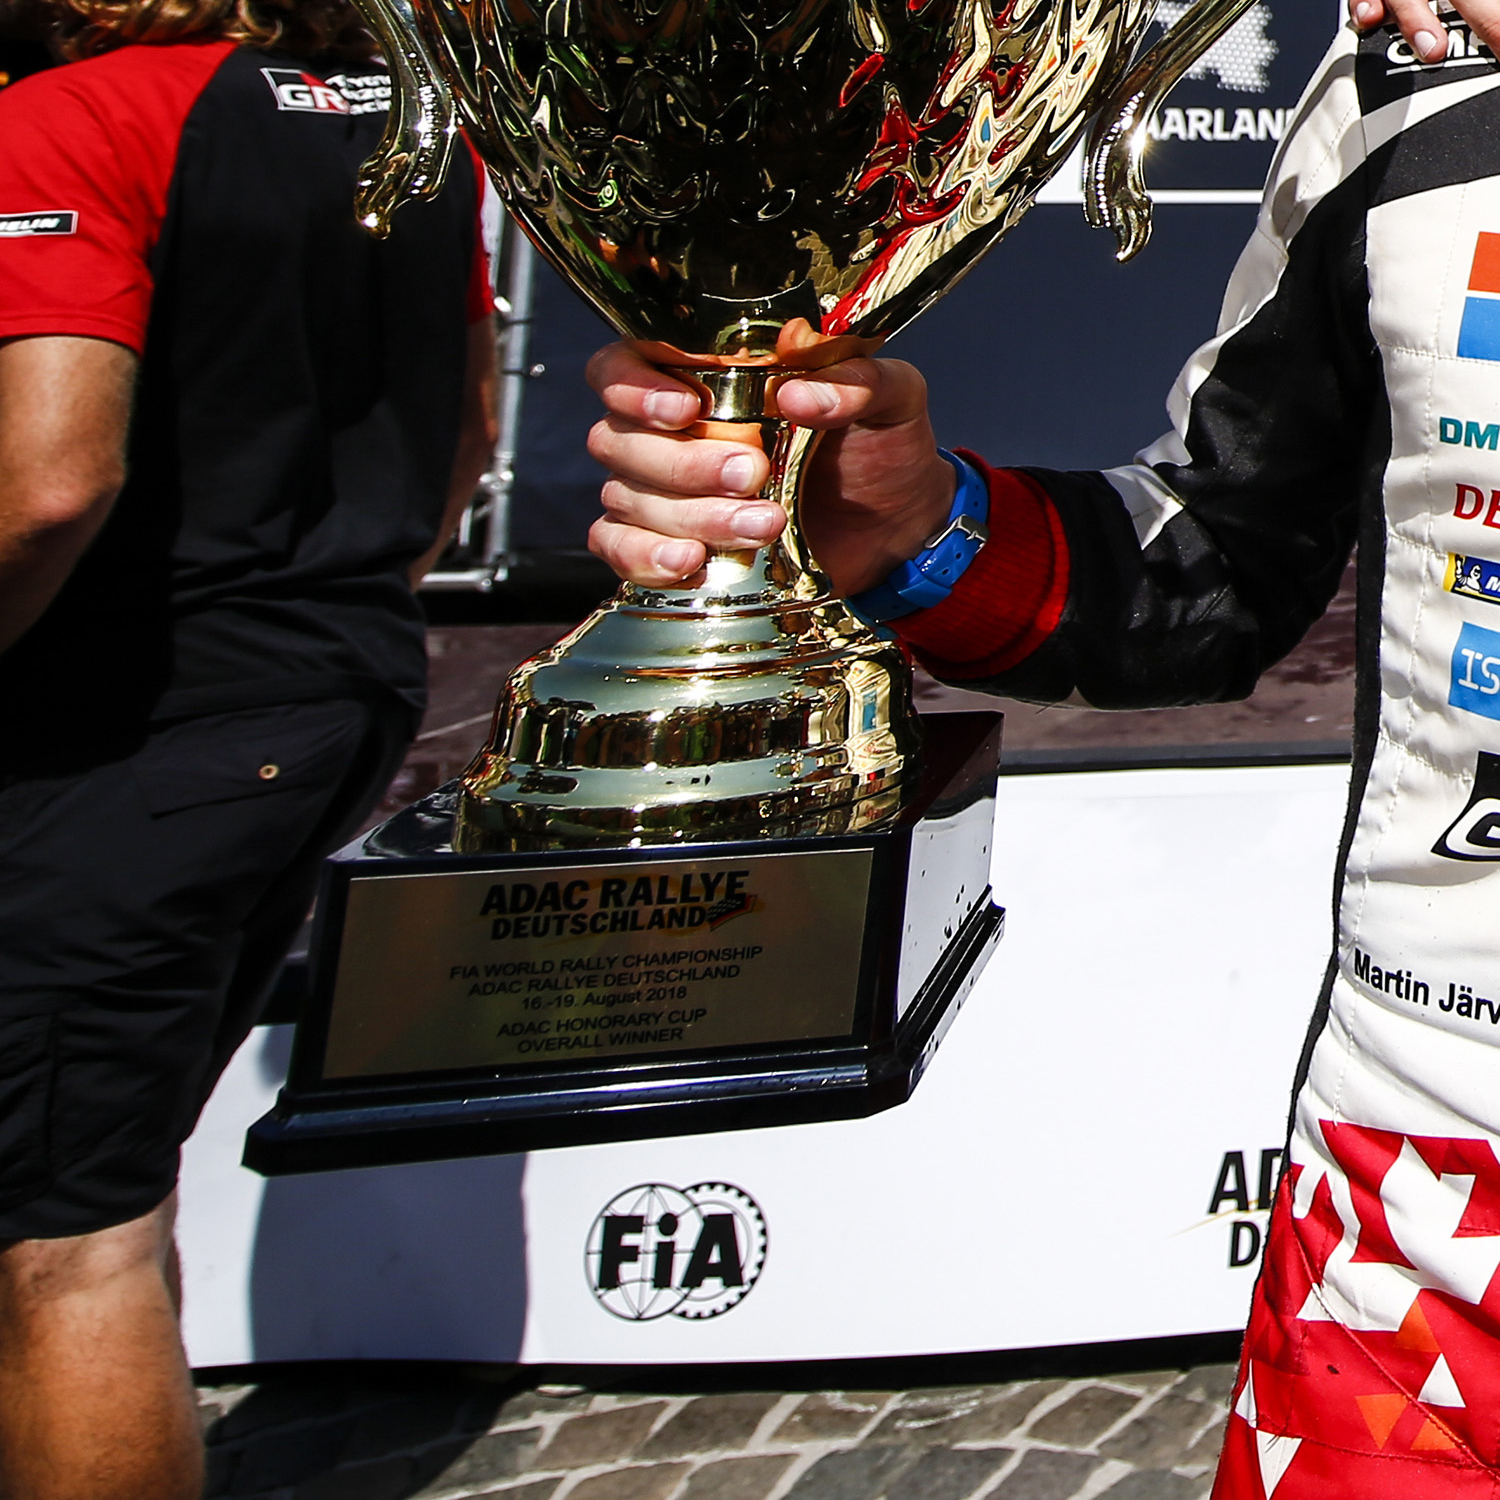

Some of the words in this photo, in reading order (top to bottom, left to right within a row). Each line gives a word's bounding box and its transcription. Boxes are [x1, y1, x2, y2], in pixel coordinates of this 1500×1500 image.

[277, 83, 349, 113] GR
[480, 879, 590, 916] ADAC
[601, 870, 750, 908] RALLYE
[490, 905, 707, 941] DEUTSCHLAND
[450, 965, 480, 981] FIA
[485, 961, 555, 978] WORLD
[560, 955, 618, 973] RALLY
[622, 945, 764, 970] CHAMPIONSHIP
[1354, 947, 1430, 1007] Martin
[468, 980, 522, 998] ADAC
[527, 974, 598, 993] RALLYE
[603, 964, 741, 988] DEUTSCHLAND
[583, 990, 642, 1009] August
[646, 986, 688, 1002] 2018
[497, 1021, 551, 1038] ADAC
[556, 1010, 663, 1034] HONORARY
[668, 1008, 707, 1024] CUP
[517, 1037, 604, 1055] OVERALL
[608, 1027, 684, 1047] WINNER
